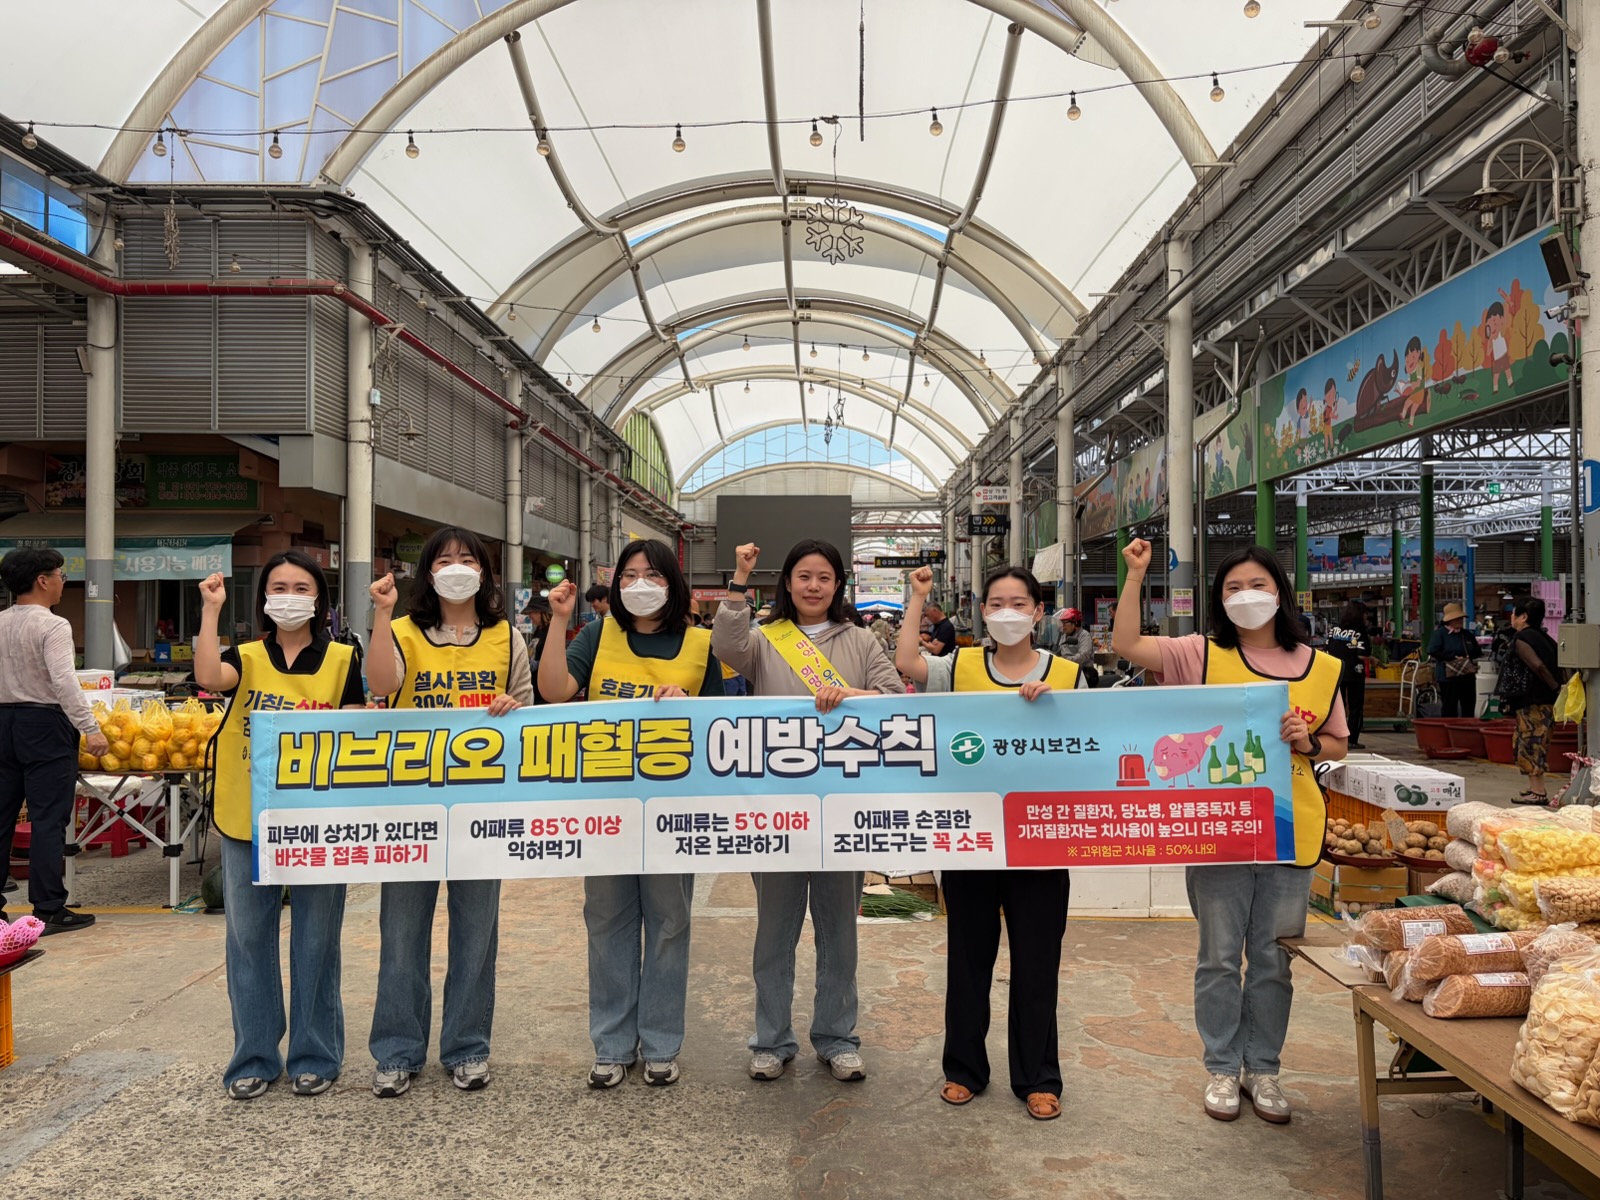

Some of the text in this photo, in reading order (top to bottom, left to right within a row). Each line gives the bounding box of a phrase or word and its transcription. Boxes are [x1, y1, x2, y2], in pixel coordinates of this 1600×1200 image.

[125, 554, 224, 572] 사용가능 매장
[275, 714, 938, 791] 비브리오 패혈증 예방수칙
[992, 736, 1101, 756] 광양시보건소
[1442, 786, 1462, 798] 매실
[854, 809, 972, 830] 어패류 손질한
[1026, 801, 1252, 820] 만성 간 질환자, 당뇨병, 알콜중독자 등
[267, 821, 438, 845] 피부에 상처가 있다면
[470, 818, 525, 839] 어패류
[584, 815, 622, 836] 이상
[656, 813, 729, 833] 어패류는
[772, 811, 810, 831] 이하
[1018, 820, 1262, 839] 기저질환자는 치사율이 높으니 더욱 주의!
[507, 839, 582, 861] 익혀먹기
[675, 834, 790, 856] 저온 보관하기
[833, 831, 994, 853] 조리도구는 꼭 소독
[1081, 845, 1123, 858] 고위험군
[1125, 845, 1156, 857] 치사율
[1165, 844, 1193, 856] 50%
[1195, 843, 1217, 855] 내외
[275, 844, 428, 867] 바닷물 접촉 피하기
